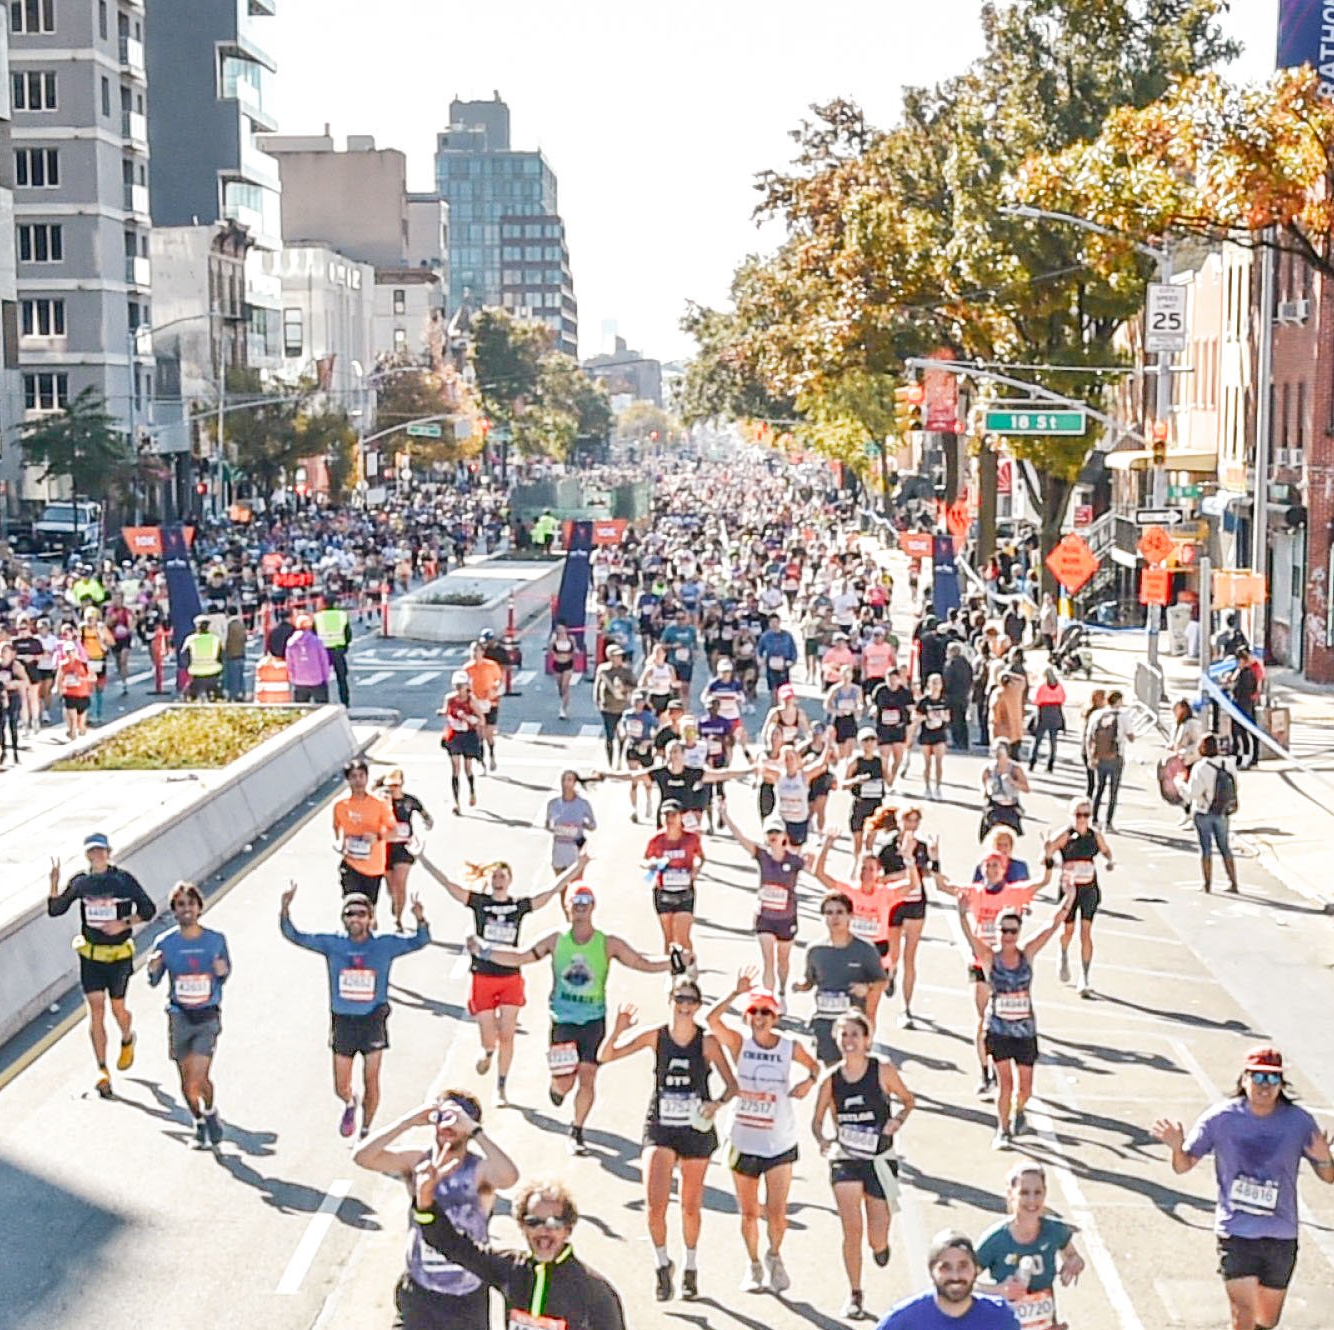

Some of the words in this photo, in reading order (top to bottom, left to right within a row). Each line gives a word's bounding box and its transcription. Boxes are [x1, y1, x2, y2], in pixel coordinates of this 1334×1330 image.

[1152, 311, 1182, 331] 25
[1010, 416, 1030, 429] 18
[1036, 416, 1058, 429] St
[743, 1050, 782, 1063] CHERYL
[739, 1101, 771, 1114] 27517
[1017, 1300, 1052, 1319] 0720
